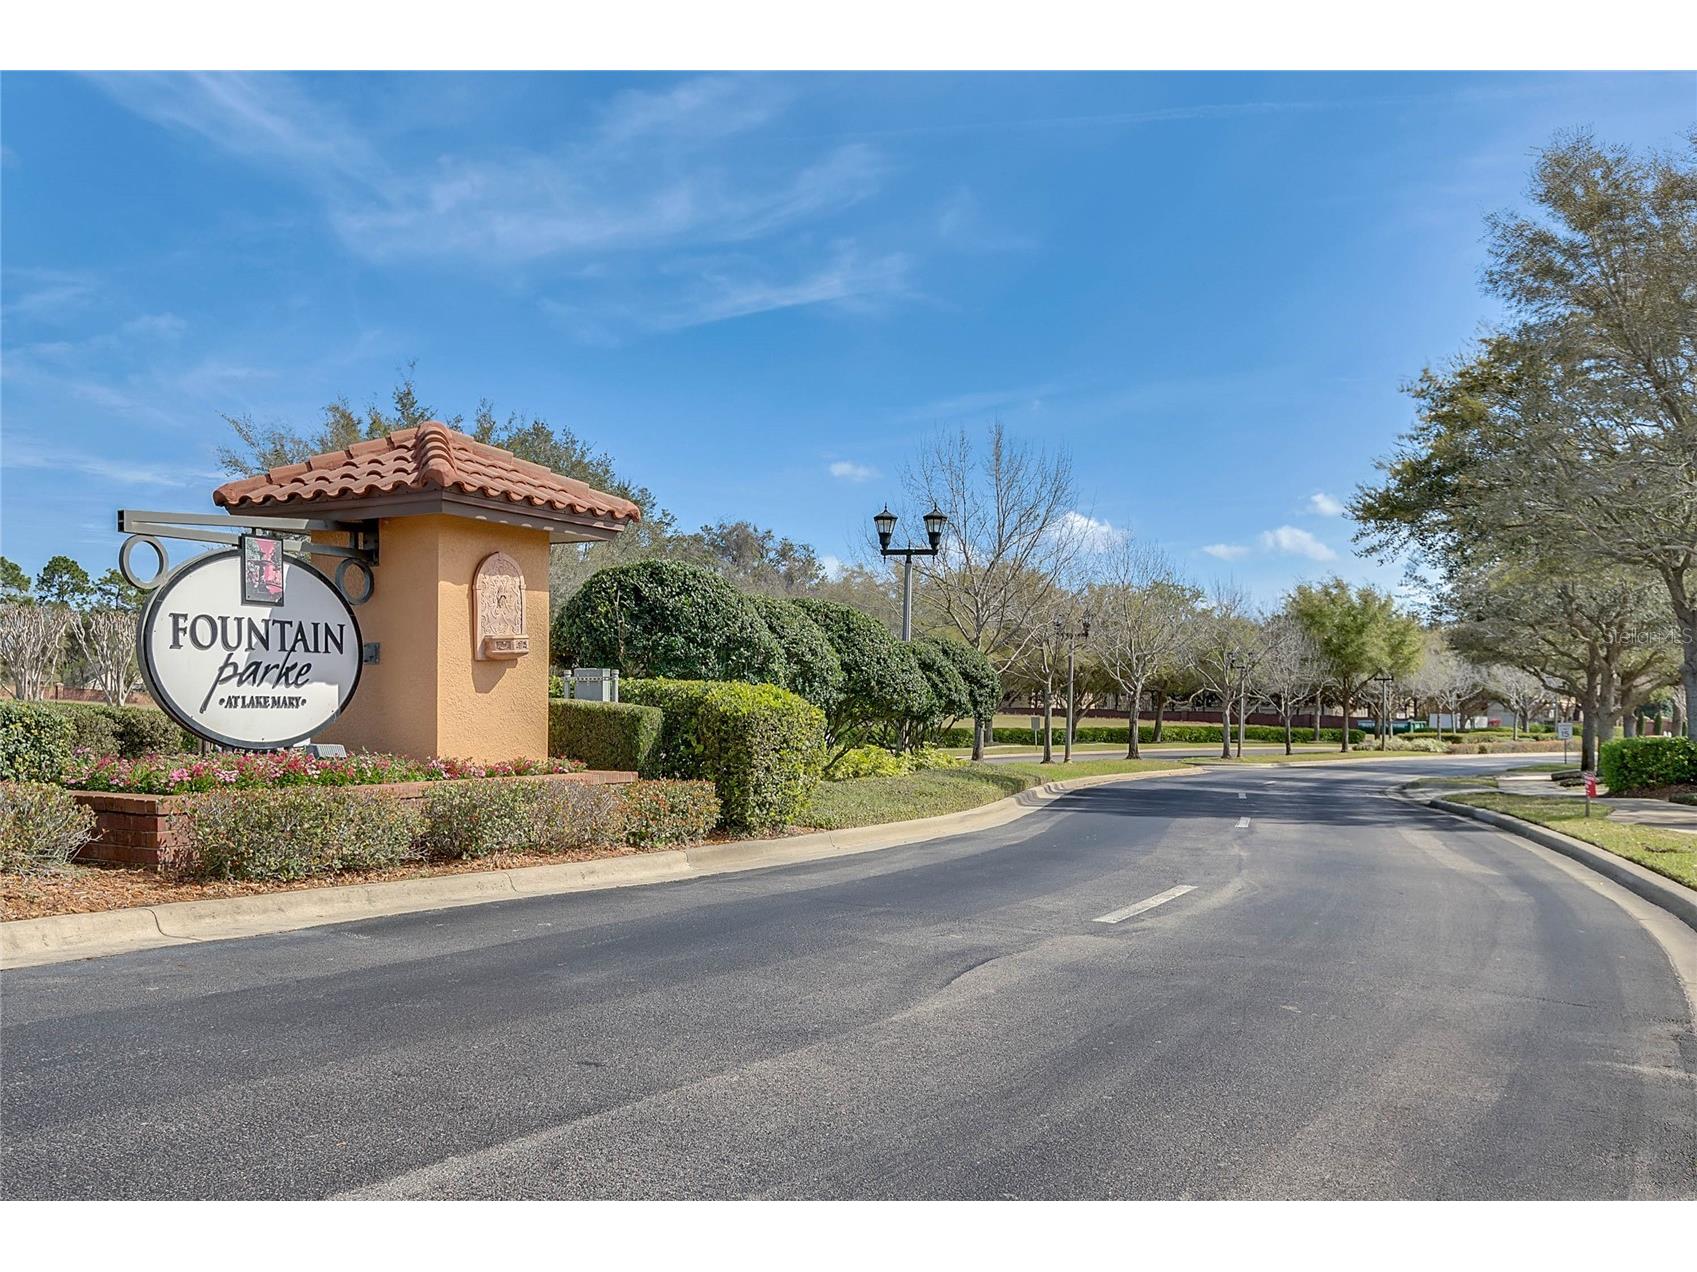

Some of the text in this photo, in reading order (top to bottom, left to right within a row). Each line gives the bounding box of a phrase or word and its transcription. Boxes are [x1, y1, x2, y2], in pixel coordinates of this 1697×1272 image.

[168, 612, 346, 655] FOUNTAIN
[199, 650, 312, 714] parke
[224, 695, 302, 709] AT LAKE MARY
[1561, 730, 1570, 738] 15
